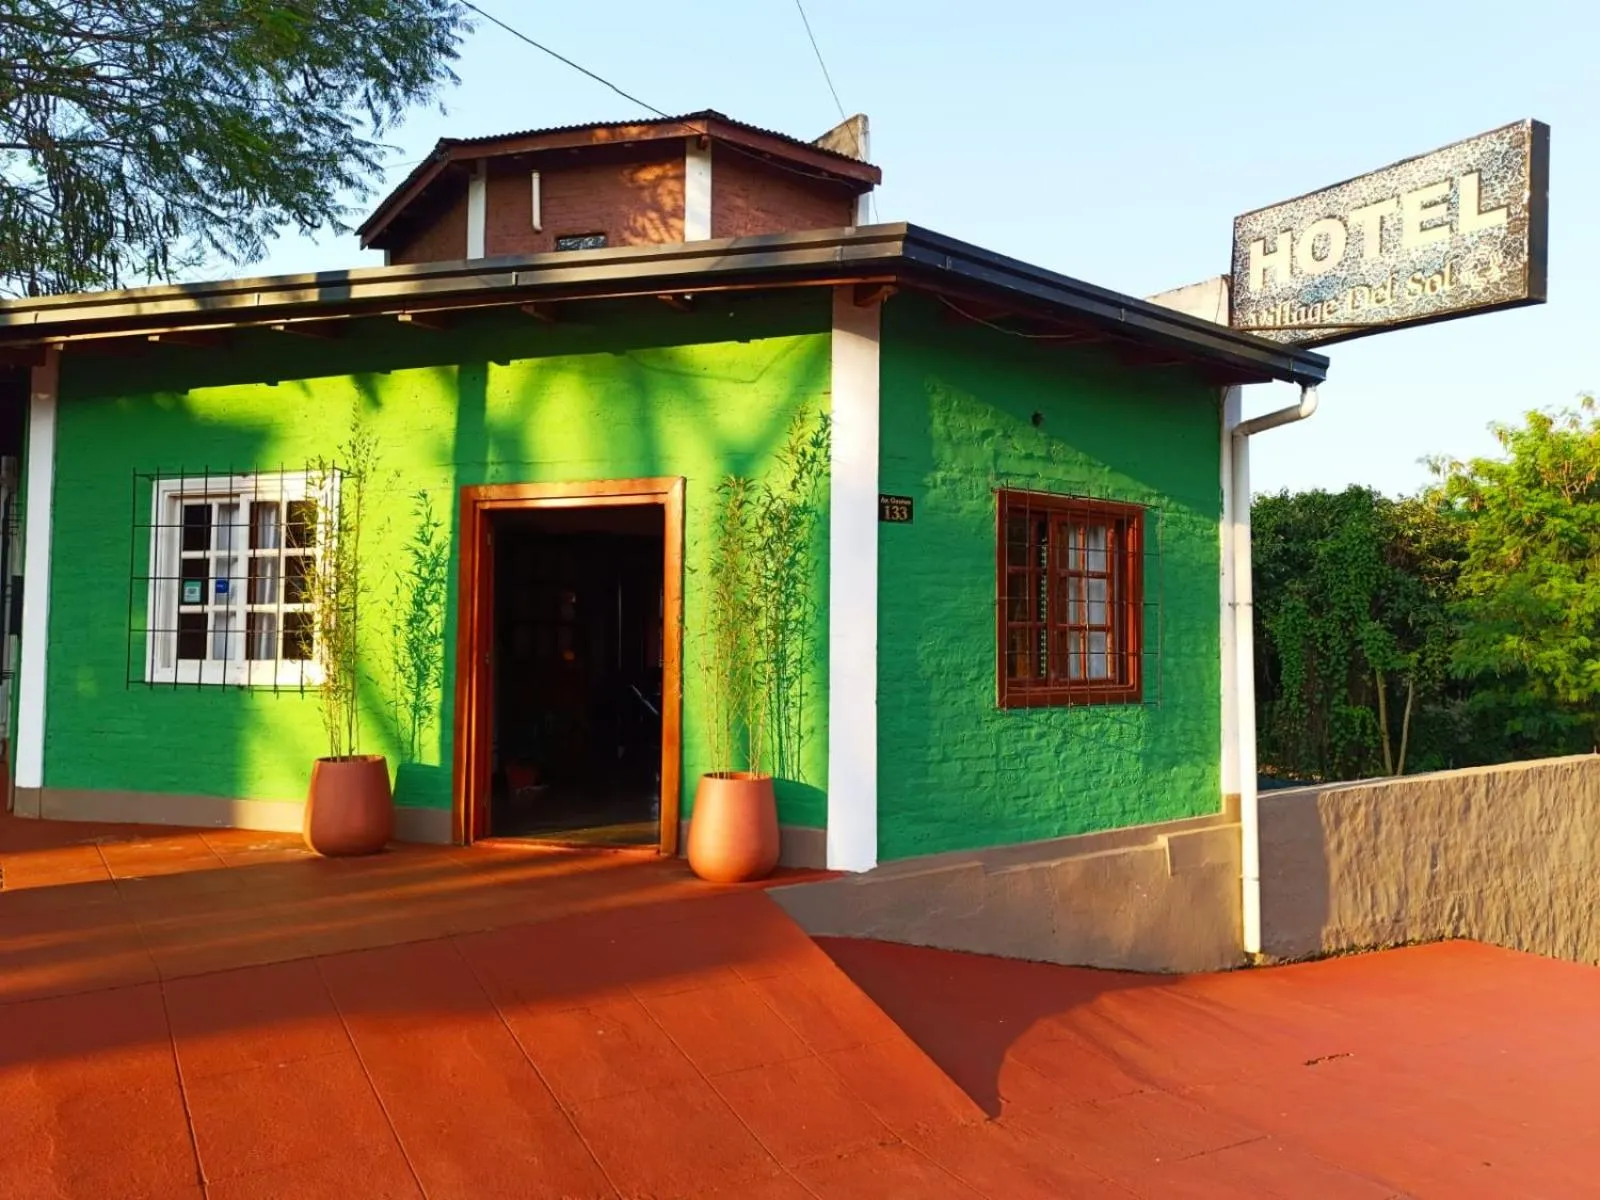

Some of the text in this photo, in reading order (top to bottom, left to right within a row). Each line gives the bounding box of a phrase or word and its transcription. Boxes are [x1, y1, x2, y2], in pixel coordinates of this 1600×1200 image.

[1249, 171, 1508, 291] HOTEL
[1349, 276, 1395, 311] Del
[1406, 264, 1456, 299] Sol
[884, 505, 908, 520] 133
